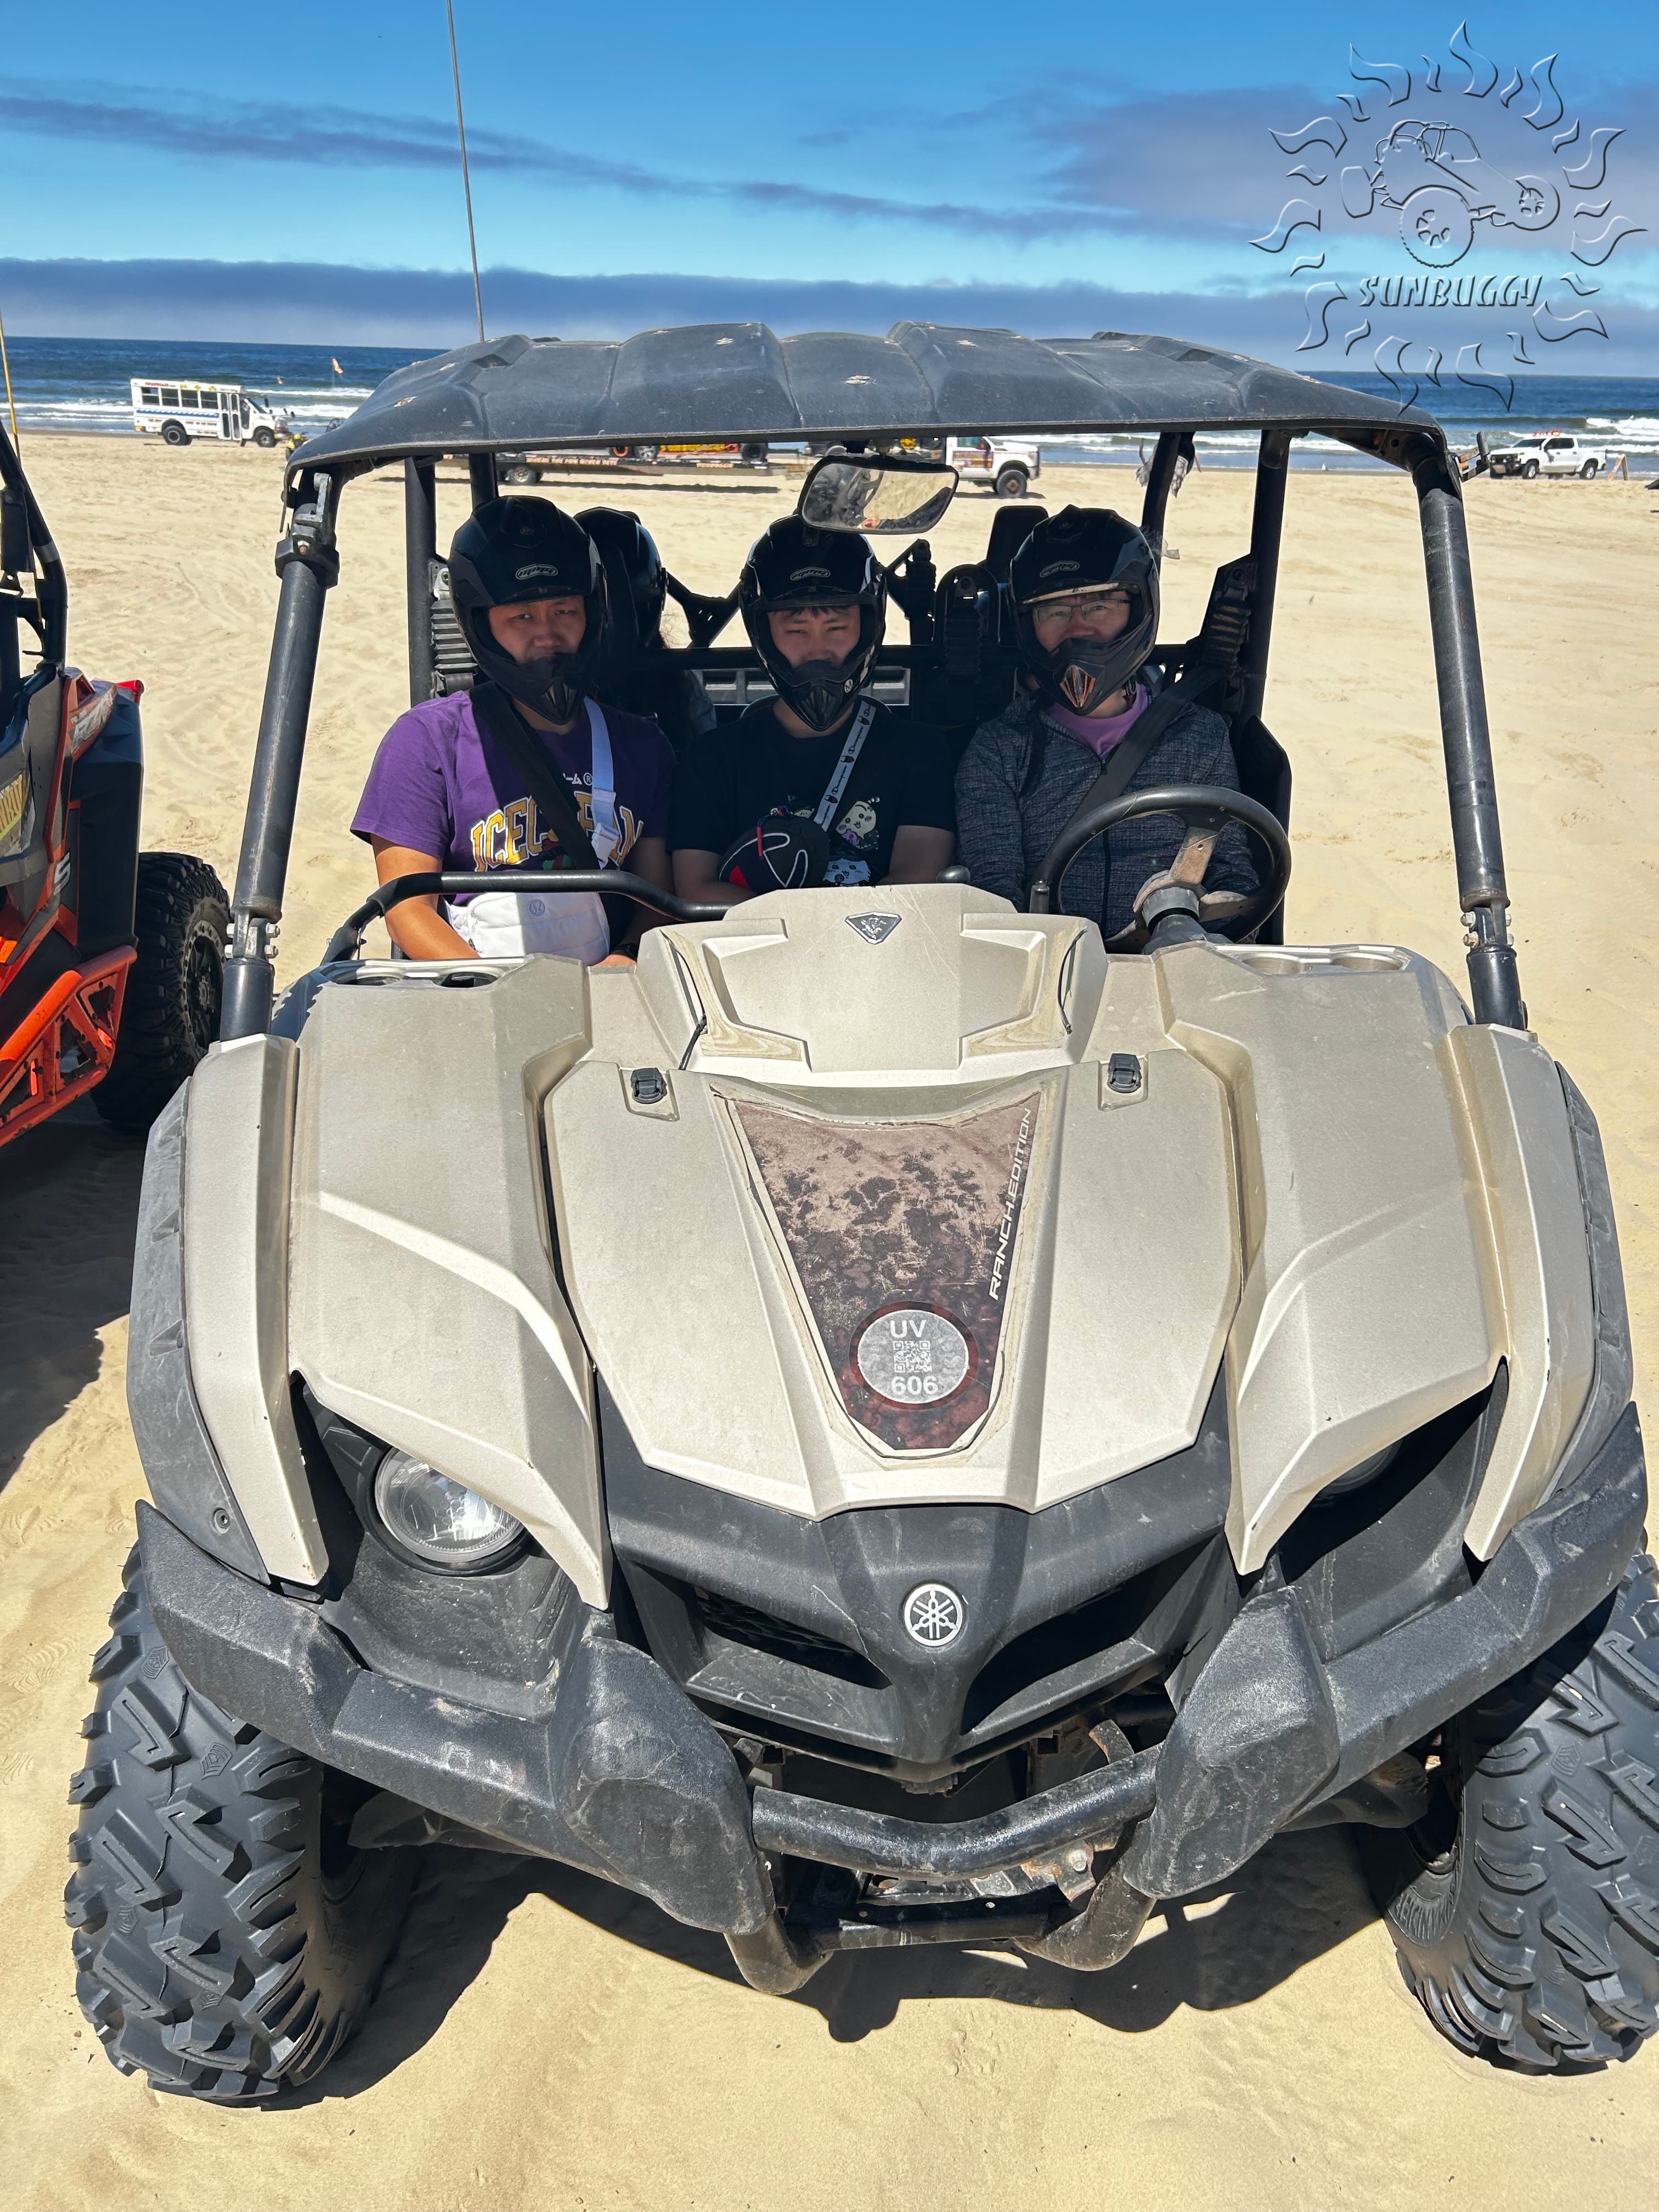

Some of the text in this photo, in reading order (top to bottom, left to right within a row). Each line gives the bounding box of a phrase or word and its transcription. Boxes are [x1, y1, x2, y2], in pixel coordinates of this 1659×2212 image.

[989, 1107, 1032, 1301] RANCH EDITION
[890, 1319, 927, 1338] UV
[890, 1375, 939, 1396] 606
